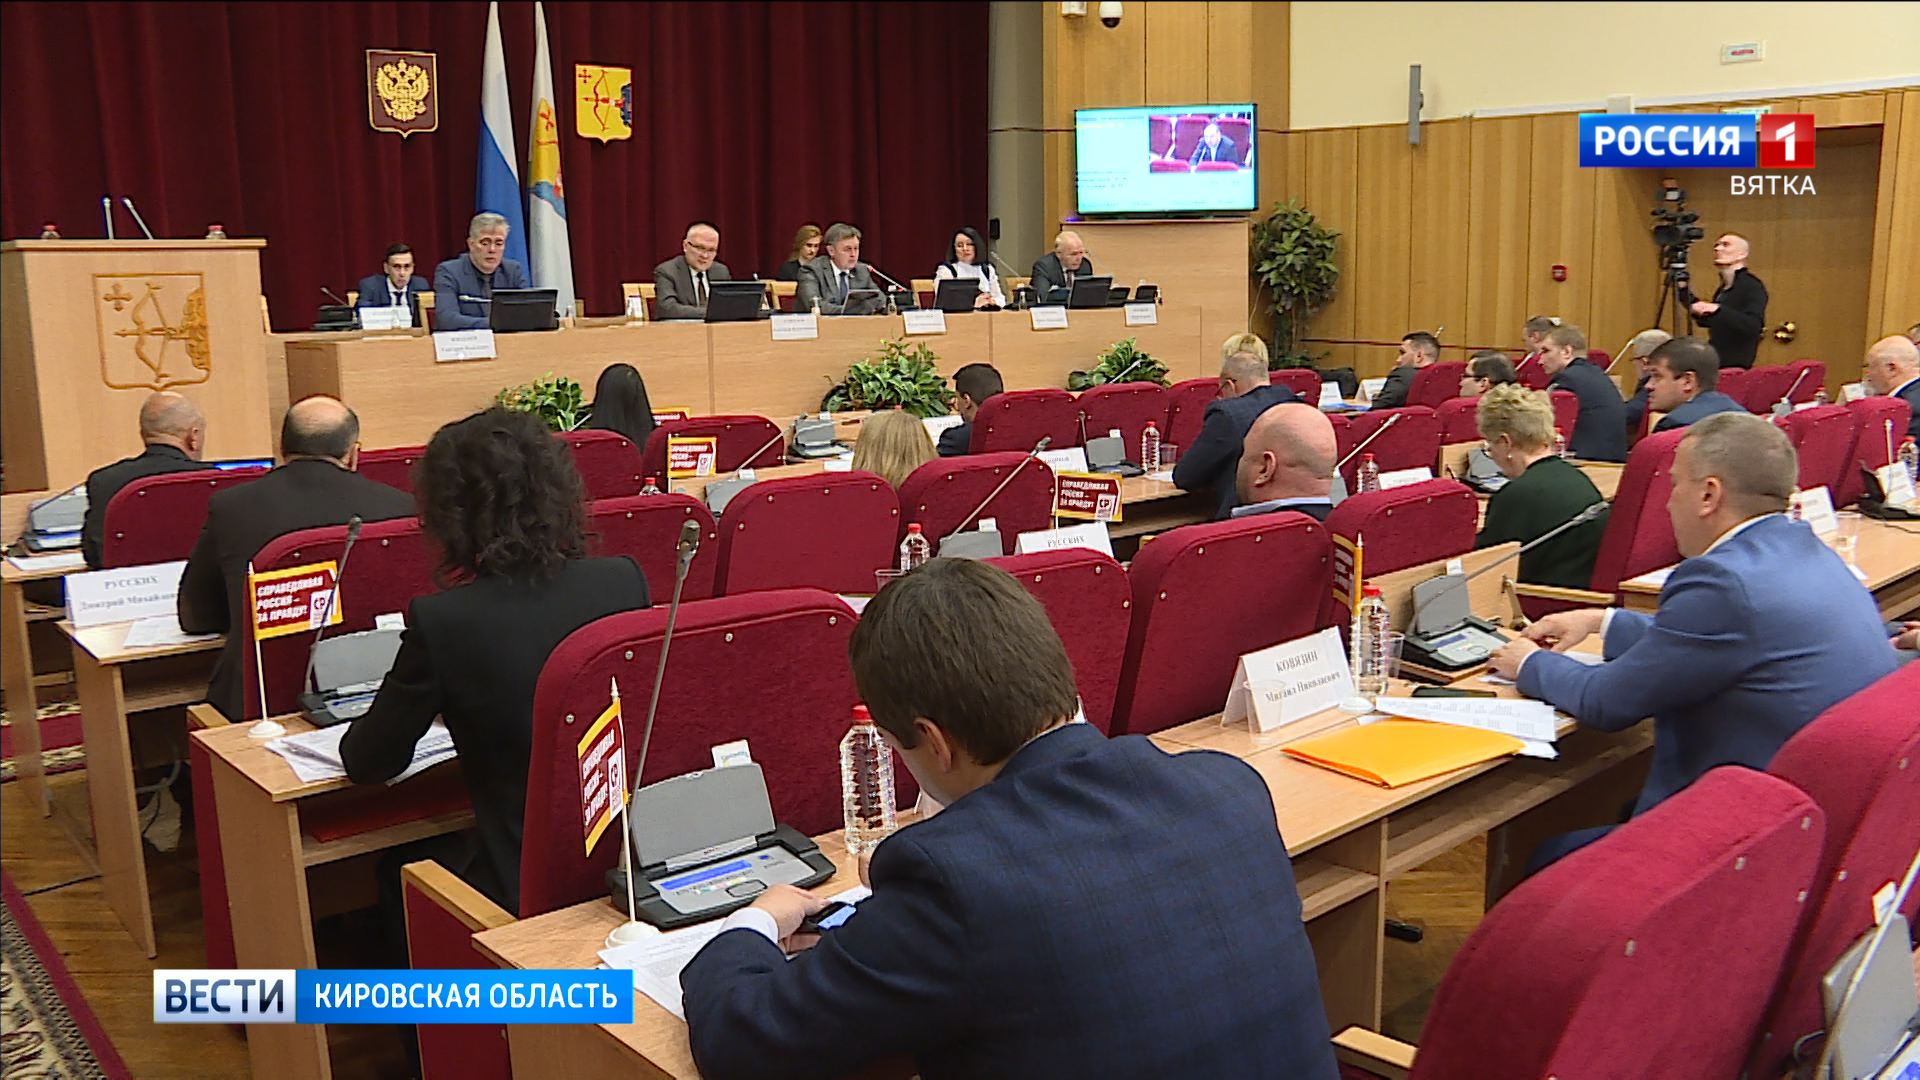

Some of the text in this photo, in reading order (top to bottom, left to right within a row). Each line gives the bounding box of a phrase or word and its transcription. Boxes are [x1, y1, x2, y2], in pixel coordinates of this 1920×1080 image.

[1062, 479, 1109, 490] СПРАВЕДЛИВАЯ
[1061, 490, 1084, 498] РОССИЯ
[1100, 499, 1109, 508] СР
[104, 576, 158, 590] РУССКИХ
[257, 575, 323, 597] СПРАВЕДЛИВАЯ
[80, 598, 124, 610] Дмитрий
[256, 595, 292, 611] РОССИЯ
[314, 597, 326, 610] СР
[256, 612, 268, 624] ЗА
[269, 605, 308, 621] ПРАВДУ!
[1276, 650, 1318, 673] КОВЯЗИН
[1265, 671, 1340, 703] Михаил Николаевич
[583, 728, 615, 780] СПРАВЕДЛИВАЯ
[611, 763, 618, 788] СР
[584, 769, 599, 803] РОССИЯ
